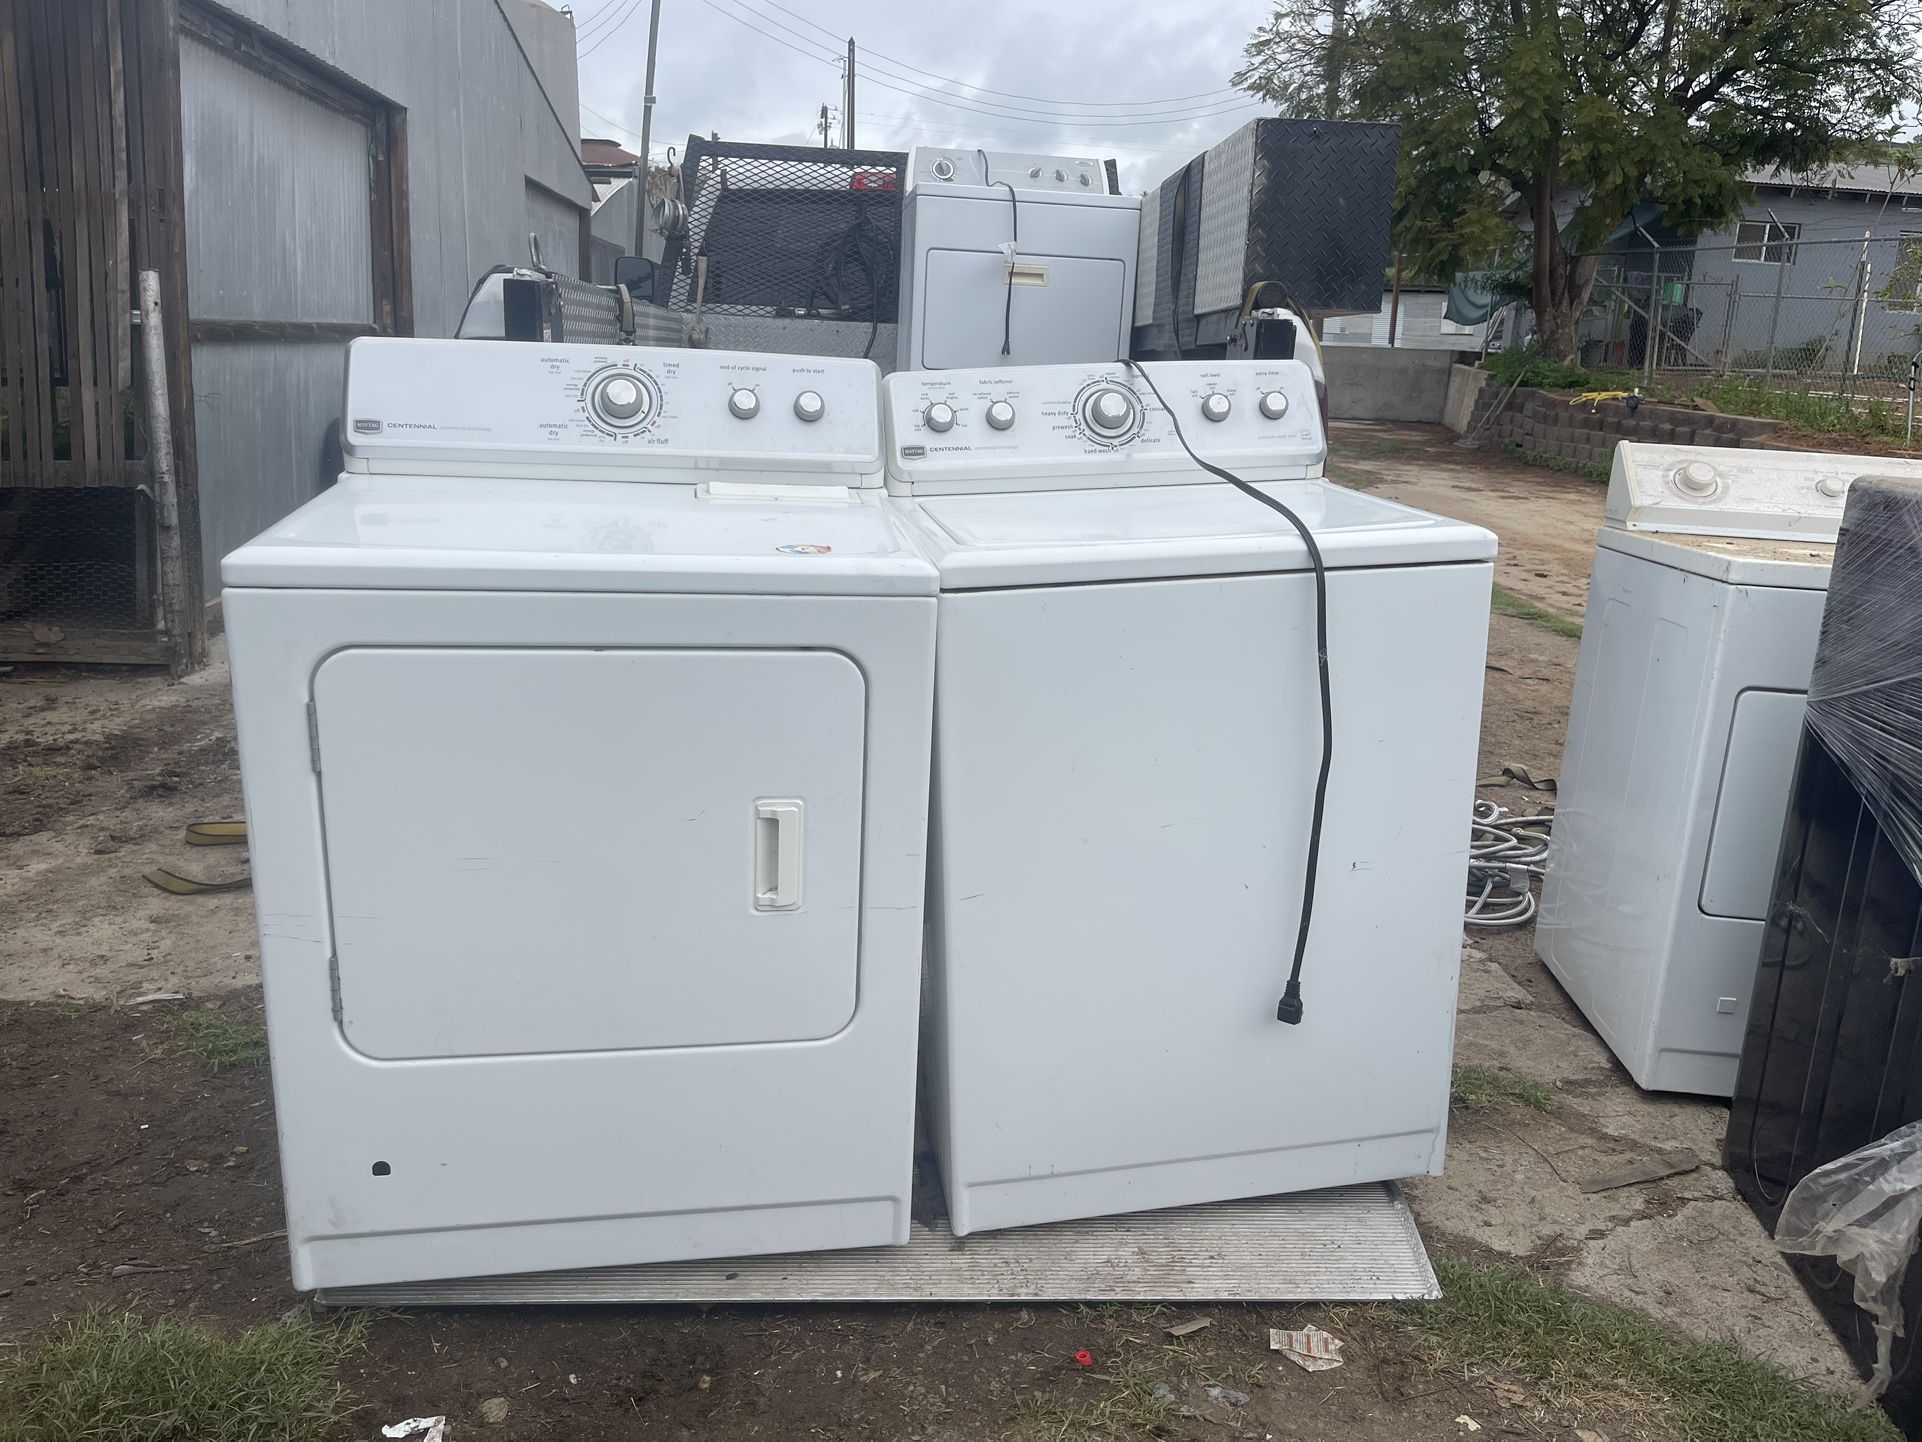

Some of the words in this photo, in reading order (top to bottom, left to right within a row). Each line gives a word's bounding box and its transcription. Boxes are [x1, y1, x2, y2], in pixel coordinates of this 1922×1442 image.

[737, 364, 751, 372] cycle
[387, 422, 438, 430] CENTENNIAL
[904, 447, 925, 455] MAYTAG
